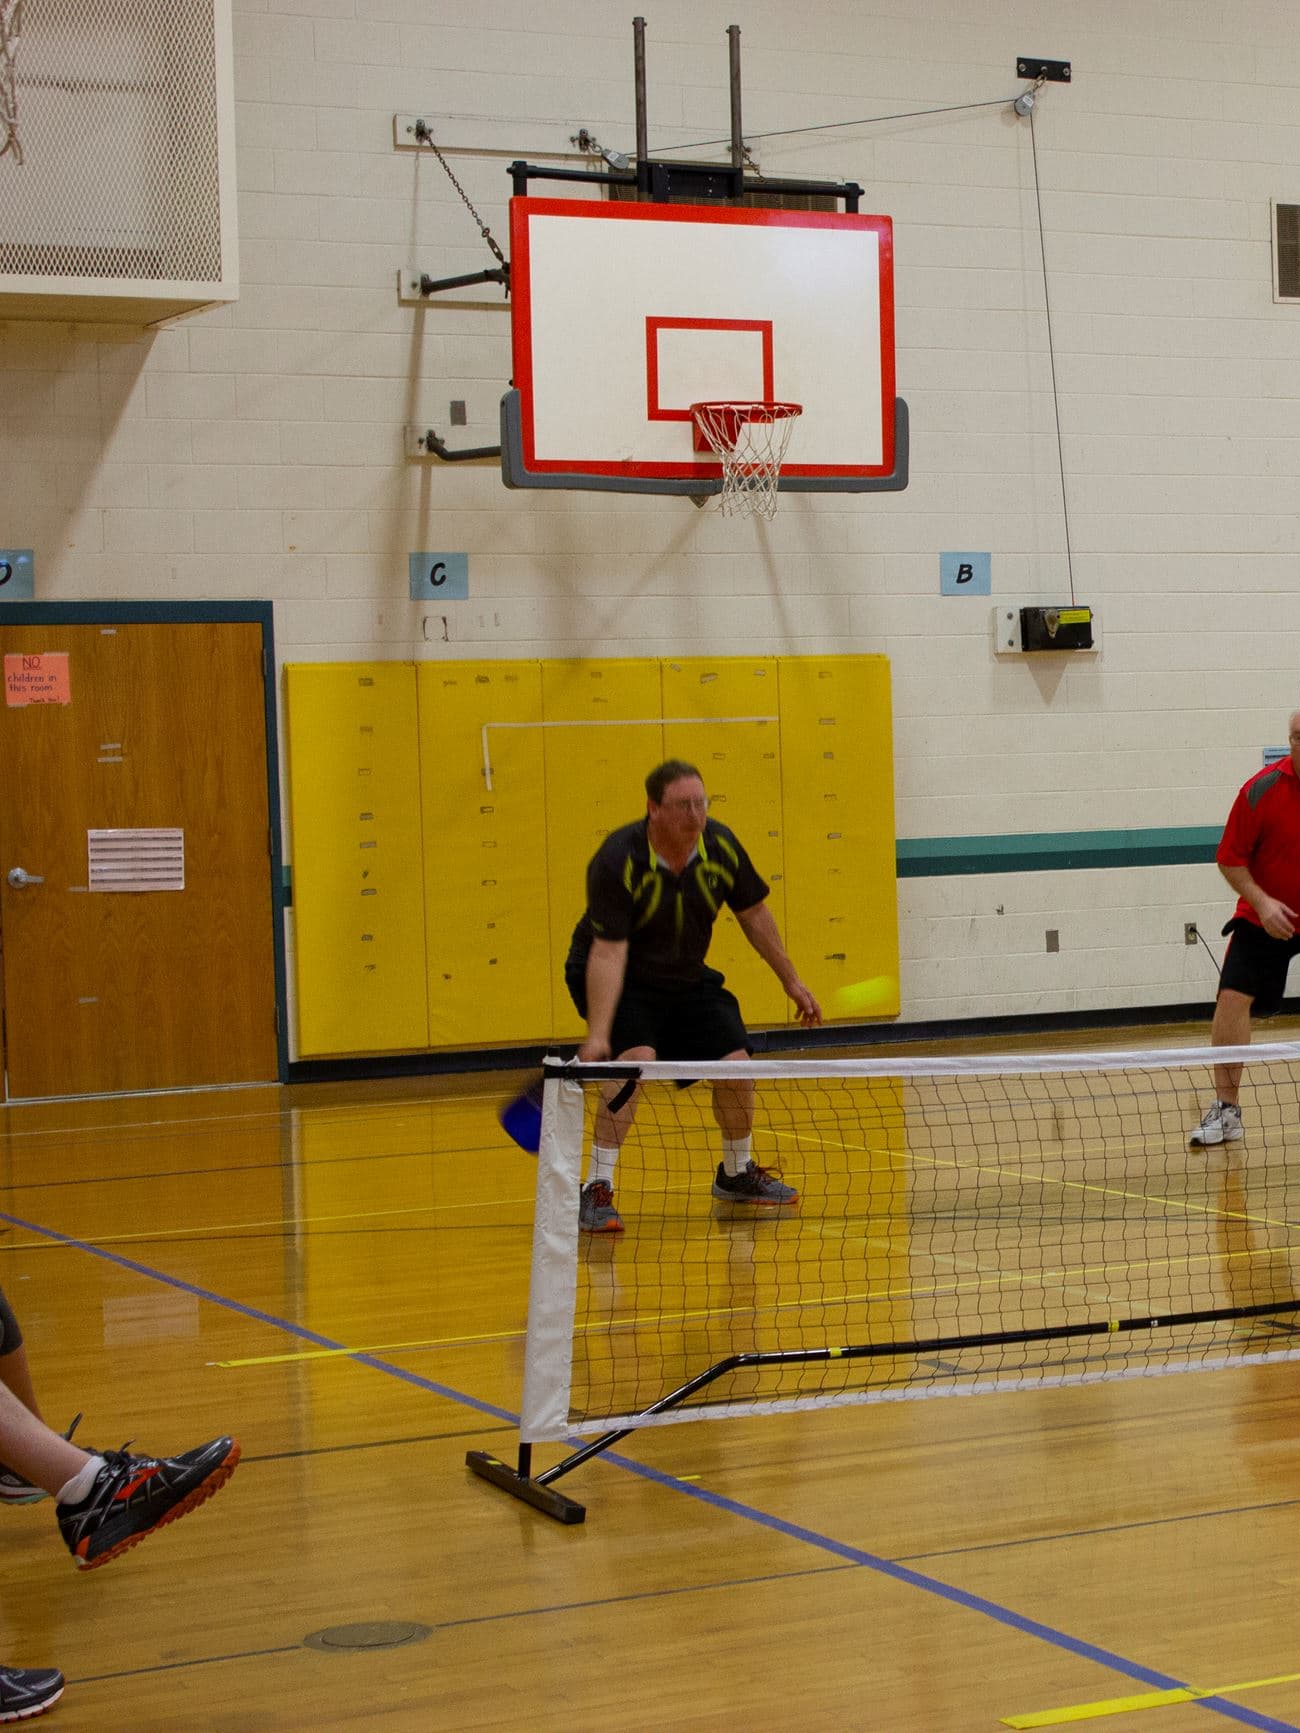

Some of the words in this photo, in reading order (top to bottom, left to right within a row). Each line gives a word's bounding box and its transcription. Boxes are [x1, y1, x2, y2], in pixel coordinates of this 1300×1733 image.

[431, 562, 446, 586] C
[956, 564, 973, 584] B
[22, 656, 41, 669] NO
[8, 672, 44, 682] children
